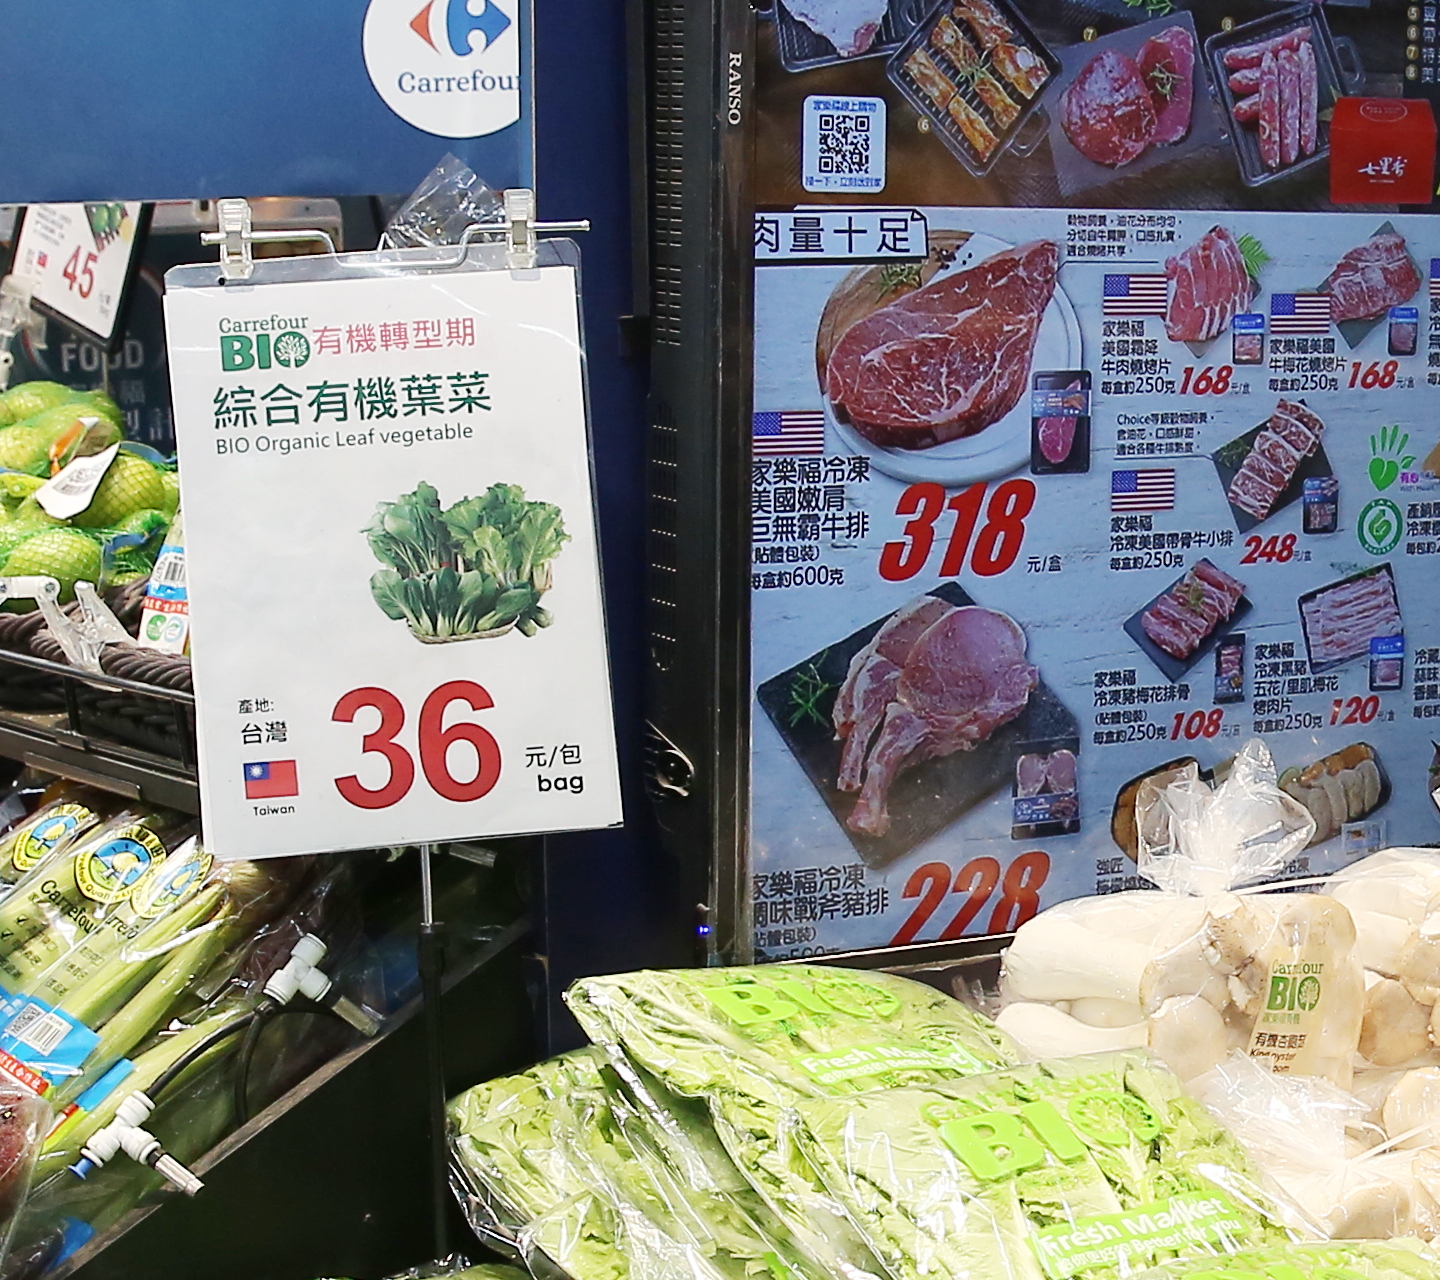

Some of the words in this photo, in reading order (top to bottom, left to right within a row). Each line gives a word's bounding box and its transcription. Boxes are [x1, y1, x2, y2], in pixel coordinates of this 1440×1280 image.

[754, 215, 911, 255] 肉量十足
[61, 244, 99, 299] 45
[218, 313, 309, 334] Carrefour
[1101, 320, 1146, 338] 家樂福
[220, 329, 312, 373] BIO
[312, 316, 476, 357] 有機轉型期
[1177, 364, 1235, 396] 168
[1345, 359, 1400, 391] 168
[212, 371, 493, 431] 綜合有機葉菜
[215, 434, 250, 455] BIO
[254, 429, 331, 455] Organic
[335, 426, 376, 448] Leaf
[379, 421, 474, 451] vegetable
[752, 455, 871, 487] 家樂福冷凍
[877, 477, 1038, 583] 318
[1109, 514, 1155, 533] 家樂福
[1239, 532, 1300, 566] 248
[1253, 641, 1295, 660] 家樂福
[1093, 668, 1138, 688] 家樂福
[1169, 707, 1225, 741] 108
[1328, 694, 1381, 726] 120
[240, 719, 289, 745] 台灣
[330, 678, 503, 811] 36
[524, 743, 582, 769] 元/包
[537, 771, 585, 795] bag
[252, 802, 296, 818] Taiwan
[888, 850, 1052, 947] 228
[699, 977, 901, 1026] BIO
[1265, 975, 1322, 1013] BIO
[939, 1091, 1162, 1181] BIO
[1039, 1215, 1123, 1258] Fresh
